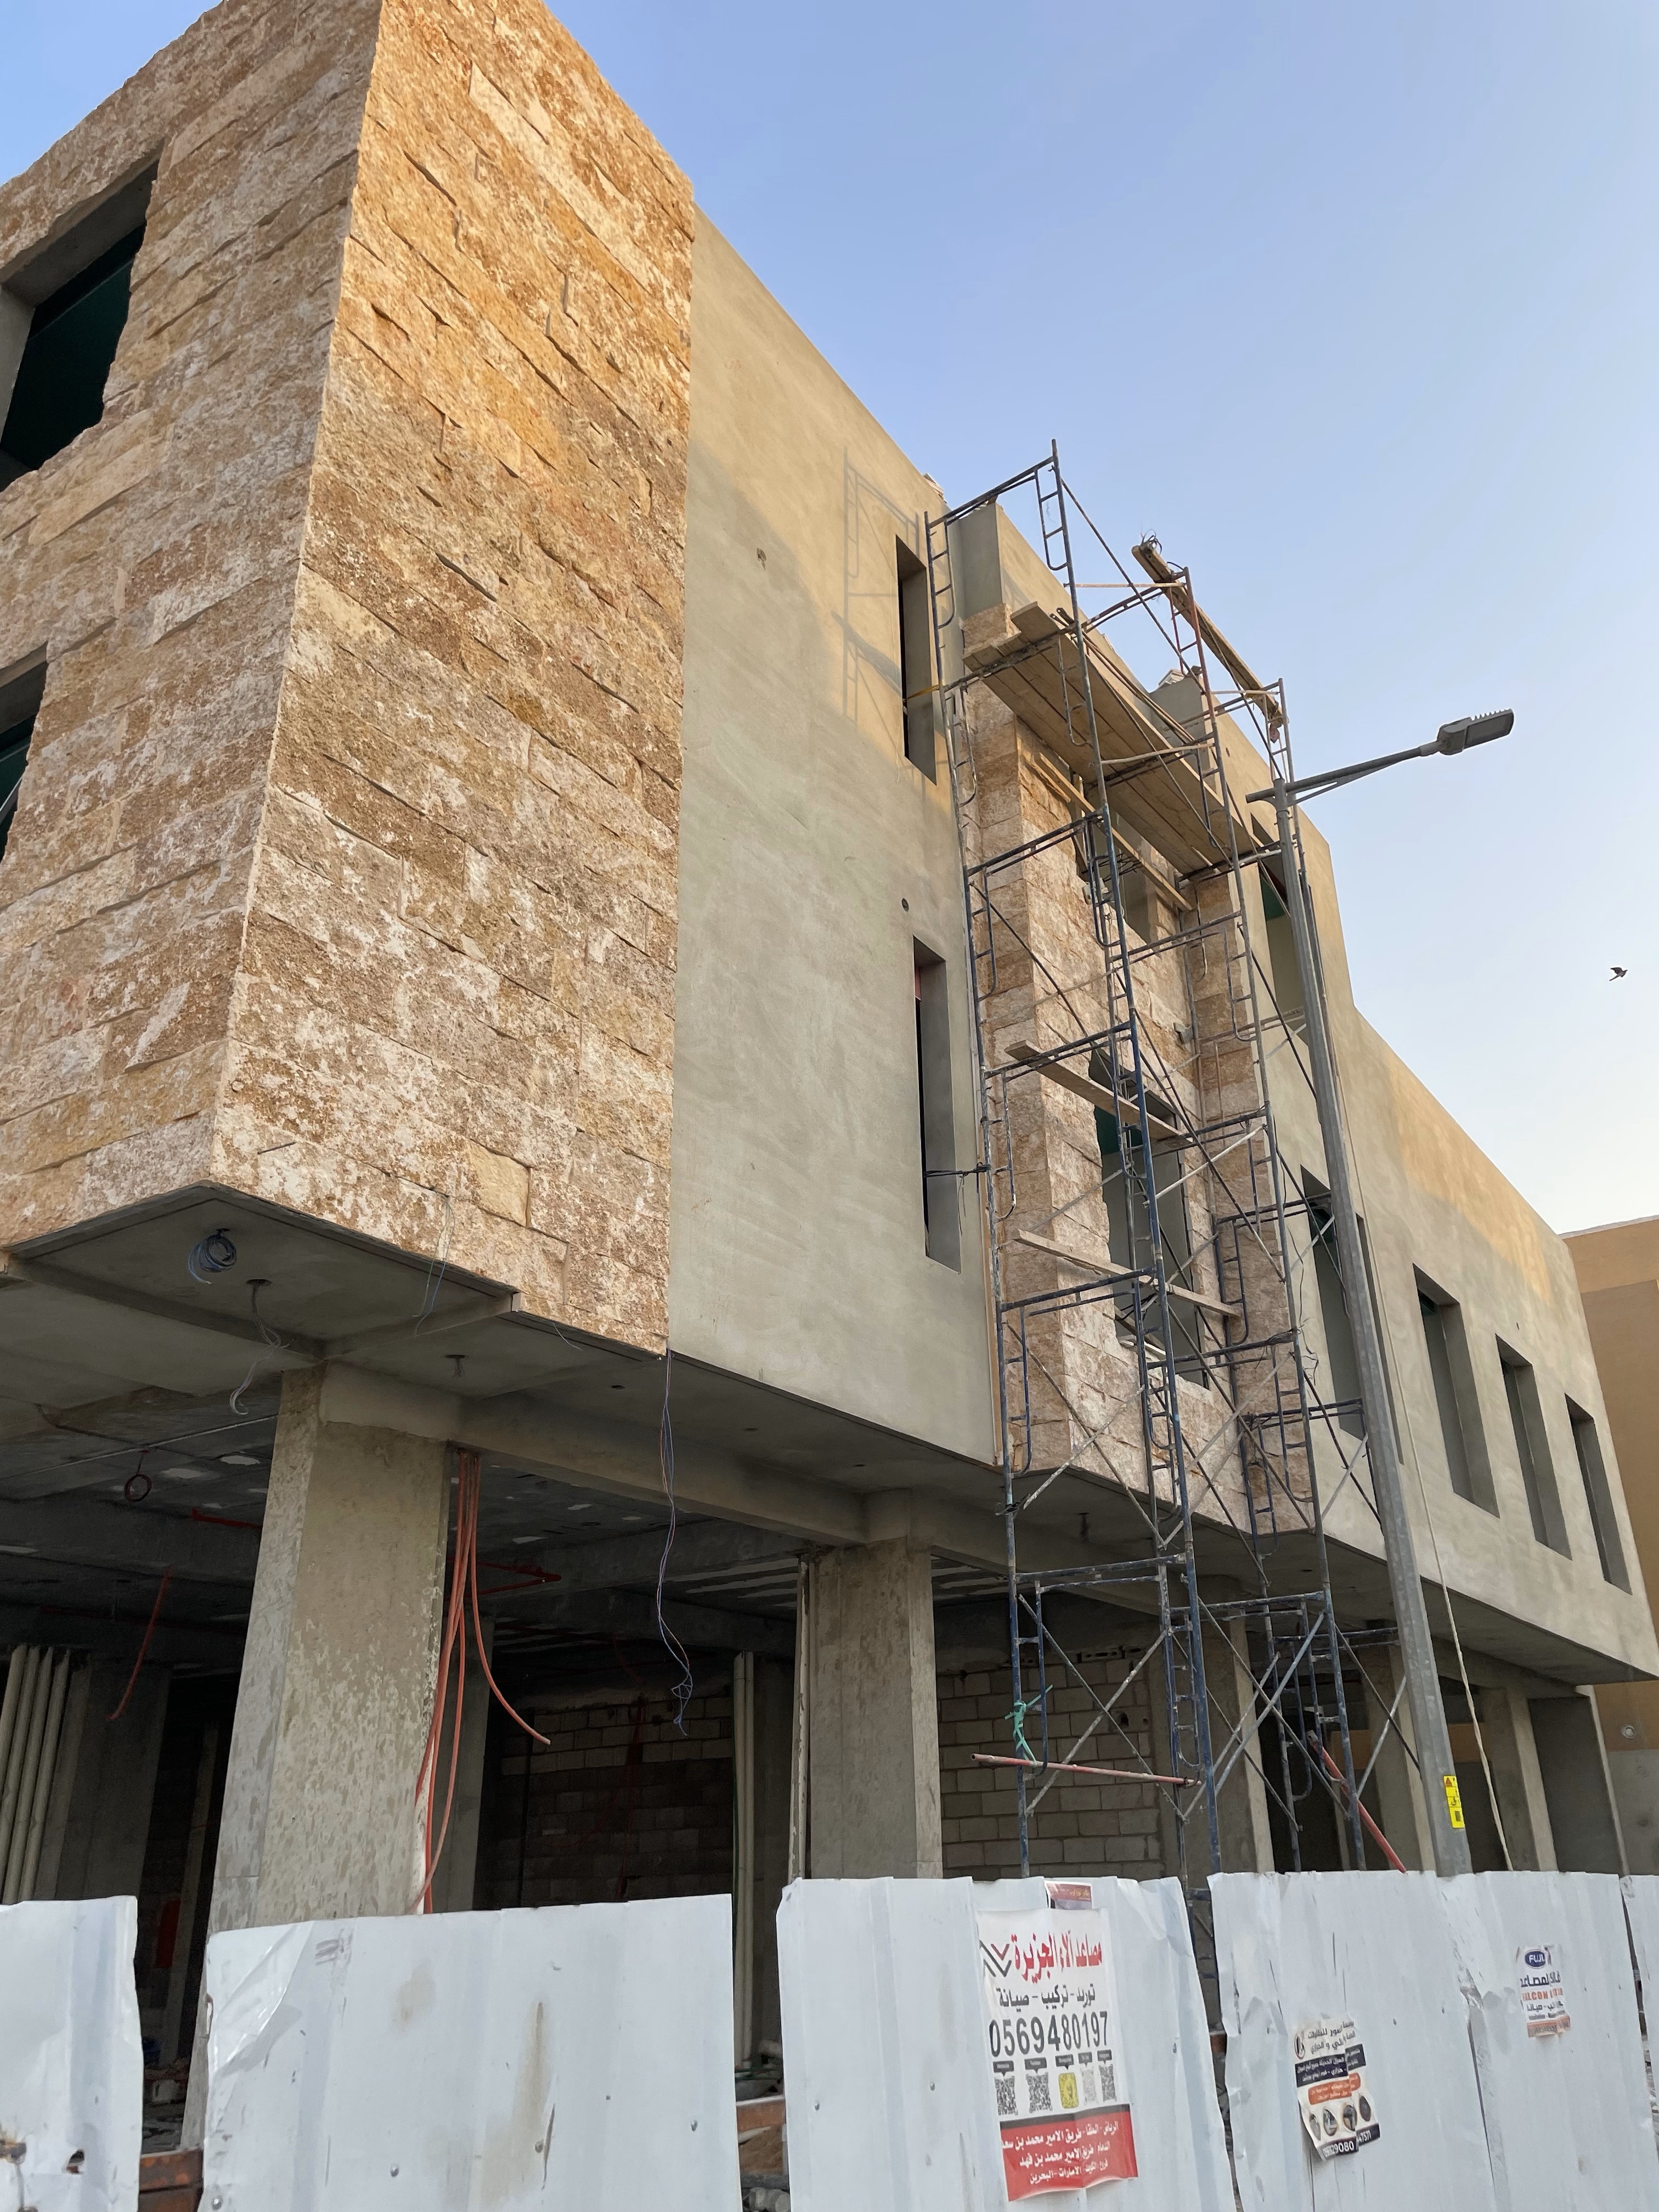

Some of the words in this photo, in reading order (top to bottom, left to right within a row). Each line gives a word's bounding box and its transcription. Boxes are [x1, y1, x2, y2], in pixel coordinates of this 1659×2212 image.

[1011, 1931, 1059, 1984] الجزيرة
[1076, 1933, 1102, 1967] مصاعد
[996, 1987, 1030, 2012] صيانة
[1041, 1984, 1069, 2009] تركيب
[1077, 1983, 1096, 2008] توريد
[989, 2011, 1107, 2057] 0569480197
[1015, 2136, 1024, 2151] بن
[1025, 2135, 1043, 2145] محمد
[1046, 2130, 1064, 2146] الامير
[1065, 2128, 1081, 2143] طريق
[1019, 2153, 1033, 2169] فهد
[1034, 2153, 1043, 2167] بن
[1045, 2152, 1063, 2162] محمد
[1064, 2147, 1081, 2163] الامير
[1030, 2170, 1053, 2185] البحرين
[1058, 2166, 1081, 2178] الامارات
